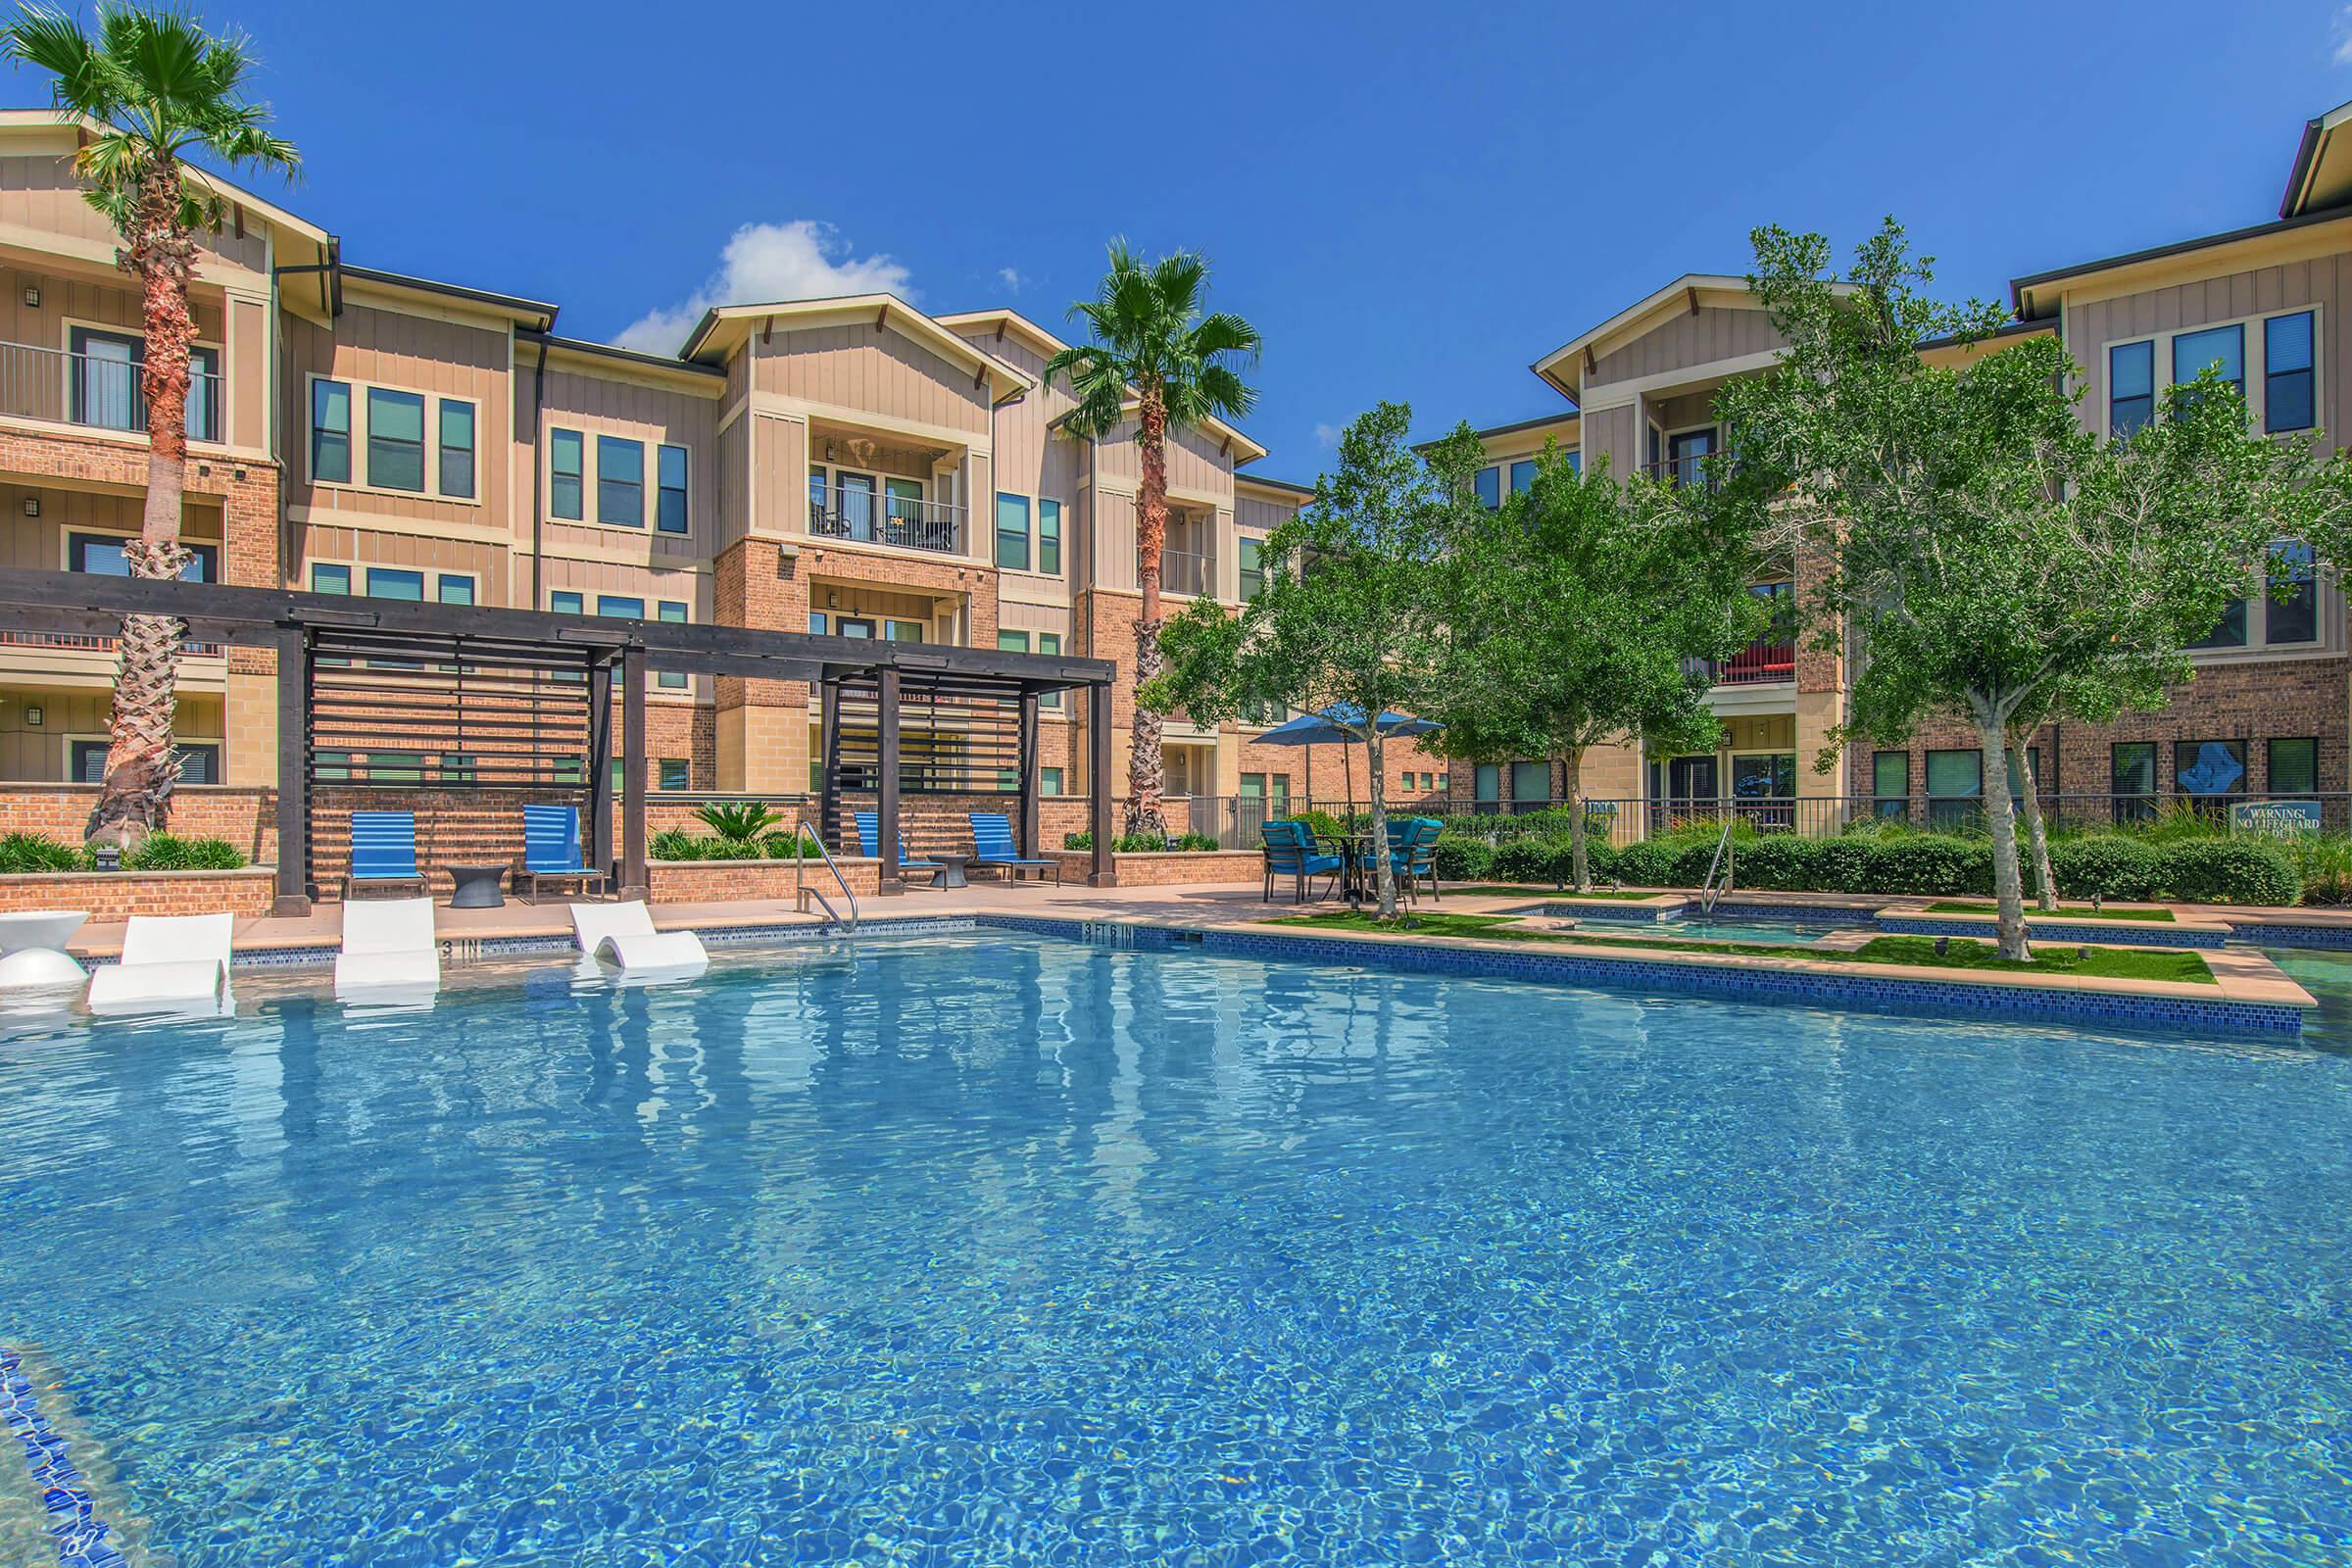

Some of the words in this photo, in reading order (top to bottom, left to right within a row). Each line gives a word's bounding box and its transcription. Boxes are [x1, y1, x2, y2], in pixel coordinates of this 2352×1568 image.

[2250, 808, 2306, 819] WARNING!
[2237, 818, 2253, 829] NO
[2256, 818, 2320, 829] LIFEGUARD
[1085, 923, 1092, 934] 3
[1096, 923, 1105, 935] FT
[1110, 924, 1117, 936] 6
[1121, 924, 1131, 938] IN
[442, 940, 453, 954] 3
[462, 939, 477, 954] IN
